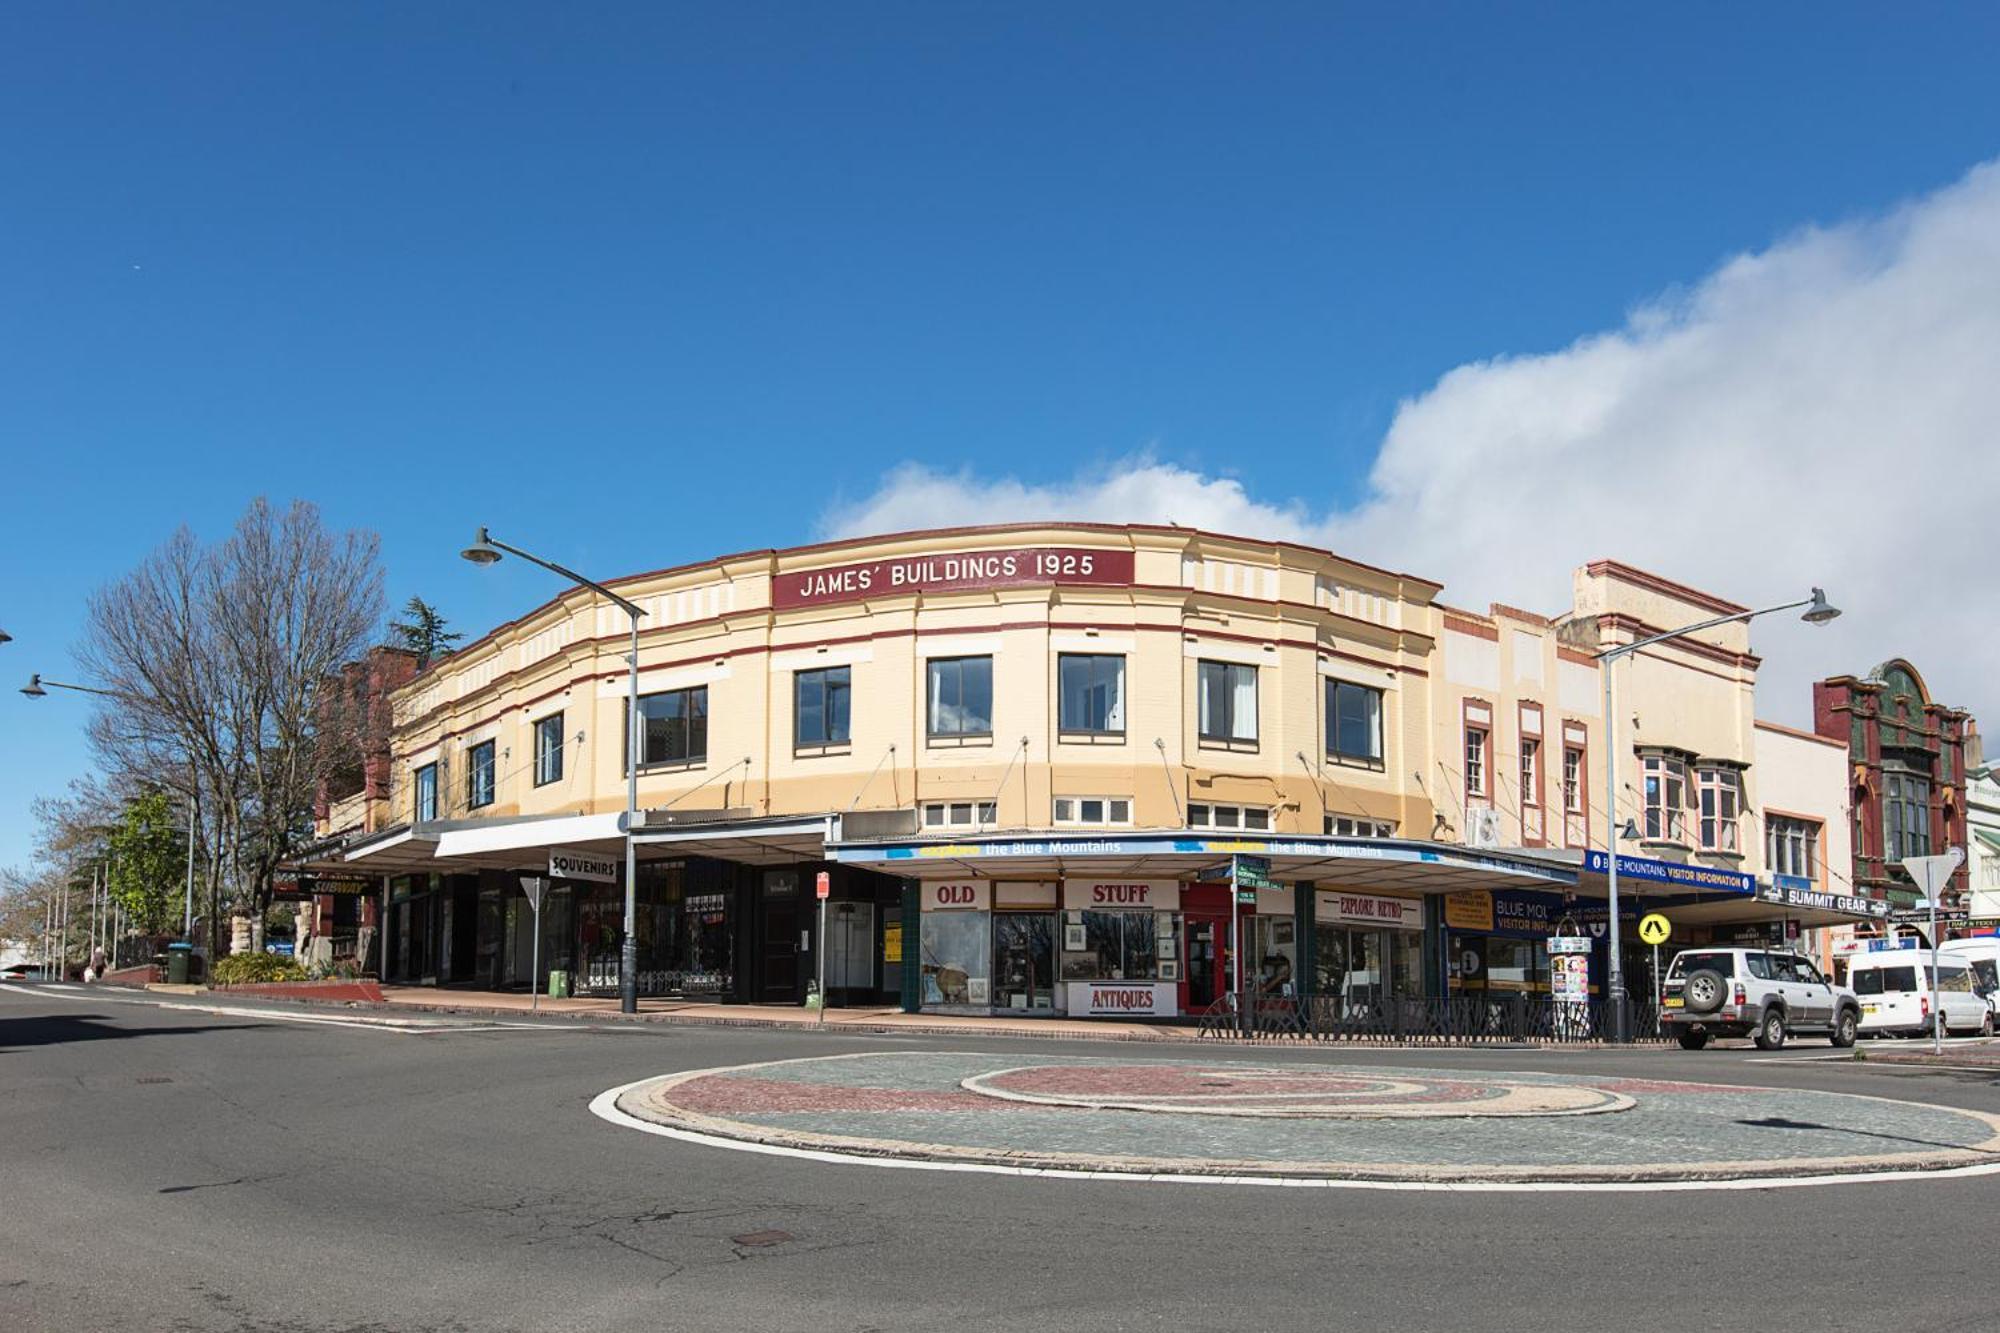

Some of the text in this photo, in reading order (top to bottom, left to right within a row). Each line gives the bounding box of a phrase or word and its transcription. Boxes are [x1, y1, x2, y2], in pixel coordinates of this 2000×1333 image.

[800, 554, 1094, 597] JAMES' BUILDINGS 1925
[986, 843, 1008, 855] the
[1012, 842, 1043, 855] Blue
[1049, 840, 1122, 854] Mountains
[1270, 841, 1290, 853] the
[1294, 841, 1321, 855] Blue
[1326, 842, 1384, 857] Mountains
[552, 856, 615, 876] SOUVENIRS
[1603, 858, 1742, 889] BE MOUNTAINS VISITOR INFORMATION
[310, 880, 369, 894] SUBWAY
[937, 885, 976, 904] OLD
[1093, 884, 1151, 903] STUFF
[1340, 896, 1403, 918] EXPLORE RETRO
[1496, 900, 1525, 917] BLUE
[1788, 890, 1867, 912] SUMMIT GEAR
[1497, 917, 1530, 931] VISITOR
[1091, 989, 1154, 1011] ANTIQUES
